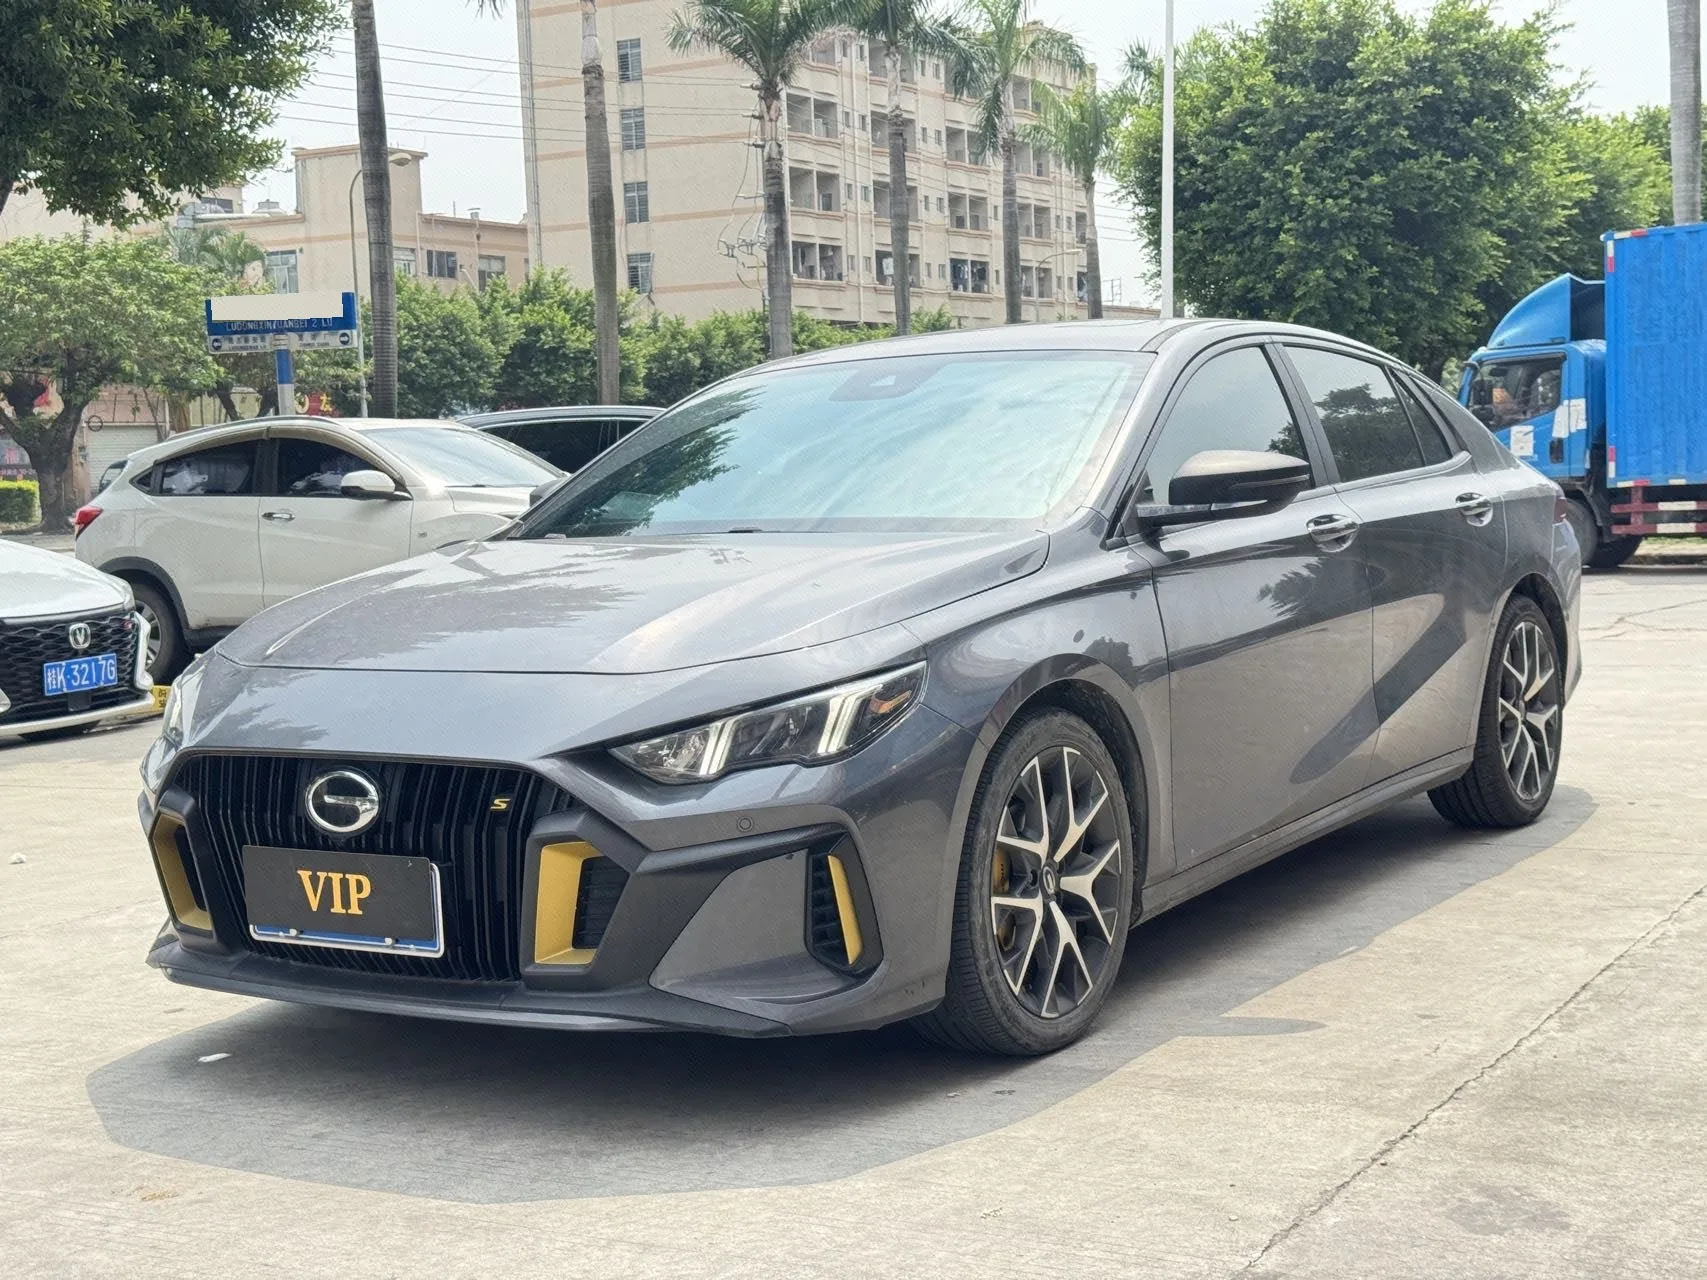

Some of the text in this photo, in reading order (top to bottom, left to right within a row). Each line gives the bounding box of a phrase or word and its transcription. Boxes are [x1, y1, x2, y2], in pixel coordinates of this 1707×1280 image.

[311, 318, 318, 328] 2
[321, 317, 333, 327] LU
[490, 797, 511, 812] S
[297, 869, 372, 916] VIP
